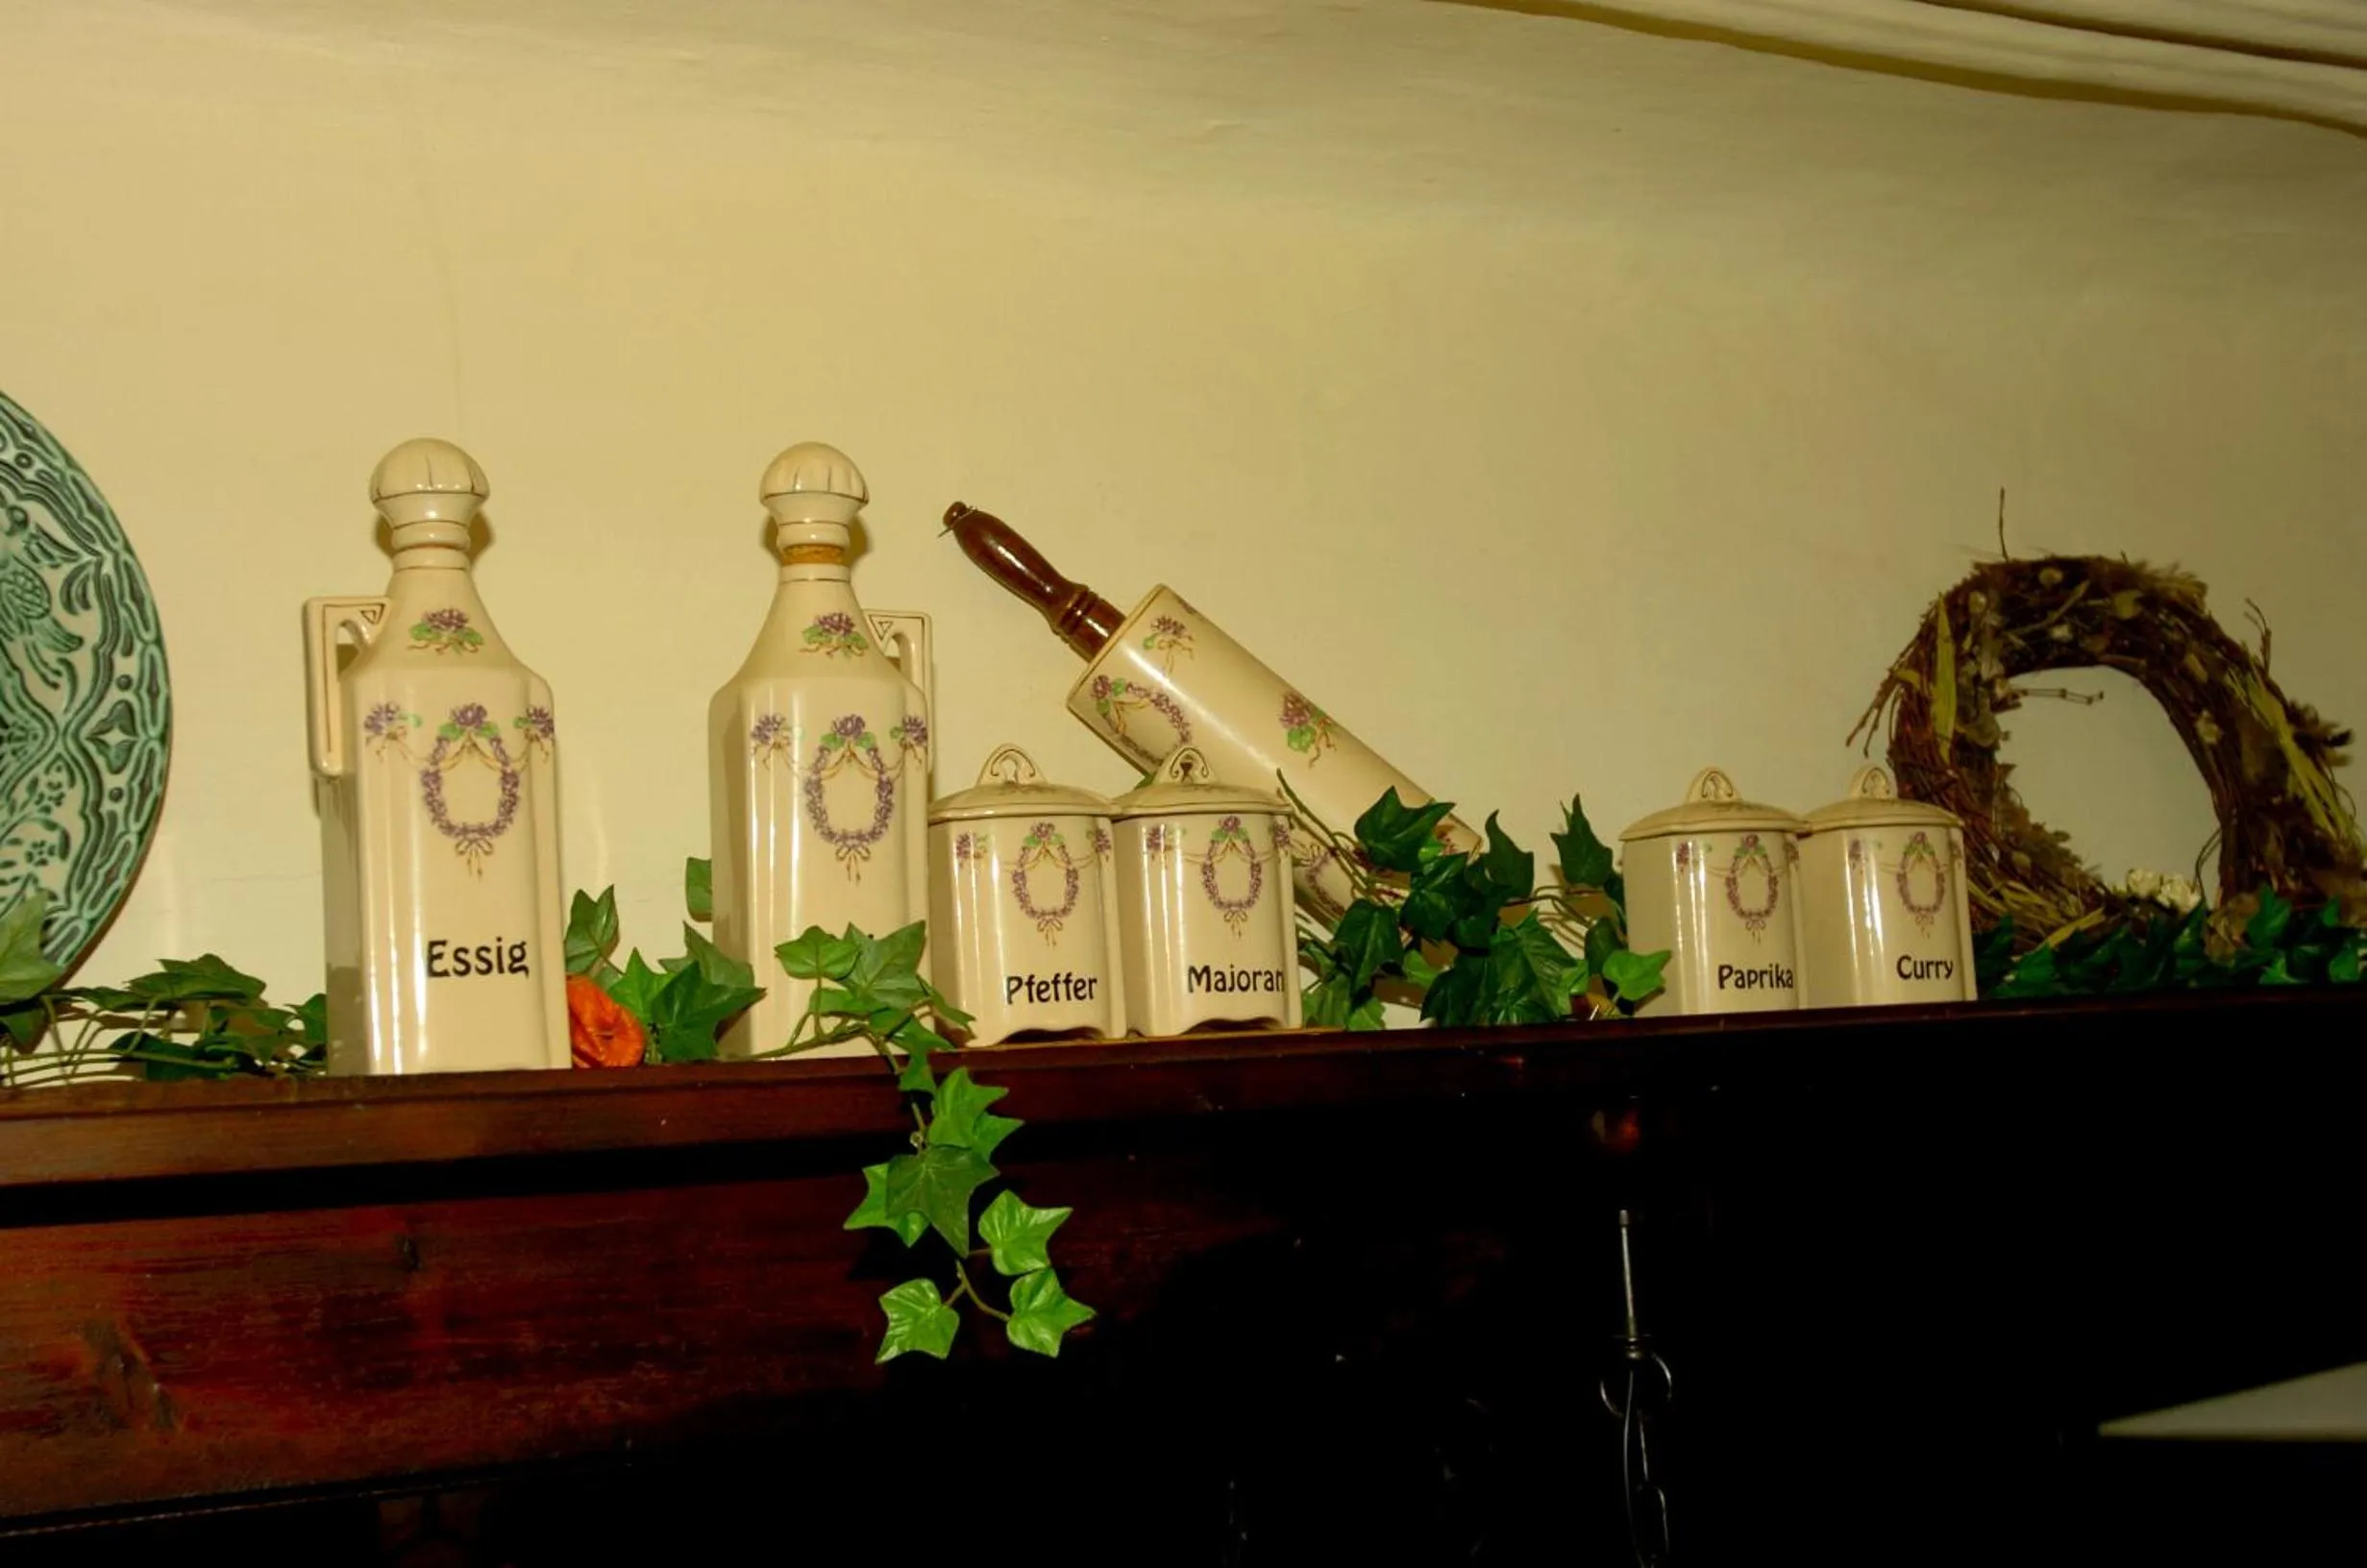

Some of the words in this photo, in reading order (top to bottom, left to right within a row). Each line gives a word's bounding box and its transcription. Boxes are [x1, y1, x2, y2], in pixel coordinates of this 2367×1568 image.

[427, 936, 530, 979] Essig
[1896, 954, 1954, 981] Curry
[1005, 971, 1097, 1004] Pfeffer
[1188, 964, 1285, 993] Majoran
[1717, 964, 1794, 990] Paprika
